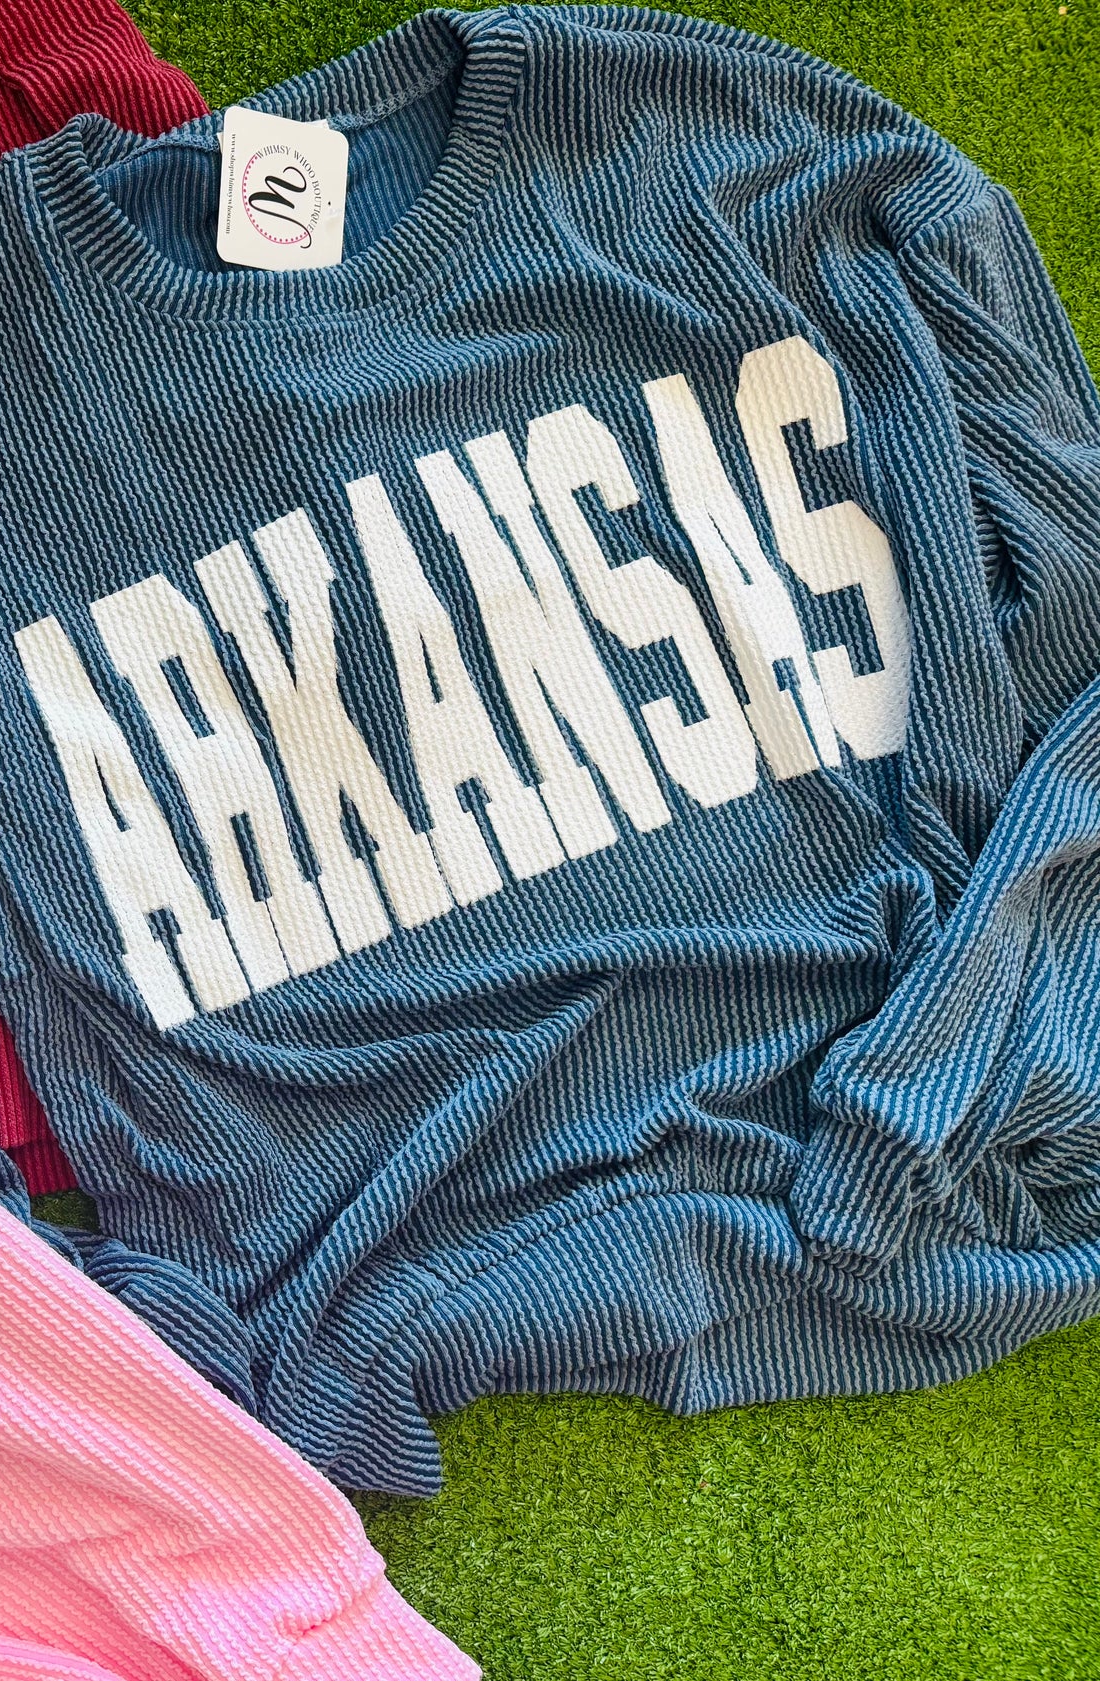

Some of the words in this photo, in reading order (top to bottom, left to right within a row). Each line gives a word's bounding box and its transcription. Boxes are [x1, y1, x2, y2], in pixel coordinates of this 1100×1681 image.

[256, 144, 291, 160] WHIMSY
[293, 150, 316, 179] WHOO
[307, 180, 322, 234] BOUTIQUE
[14, 335, 911, 1032] ARKANSAS
